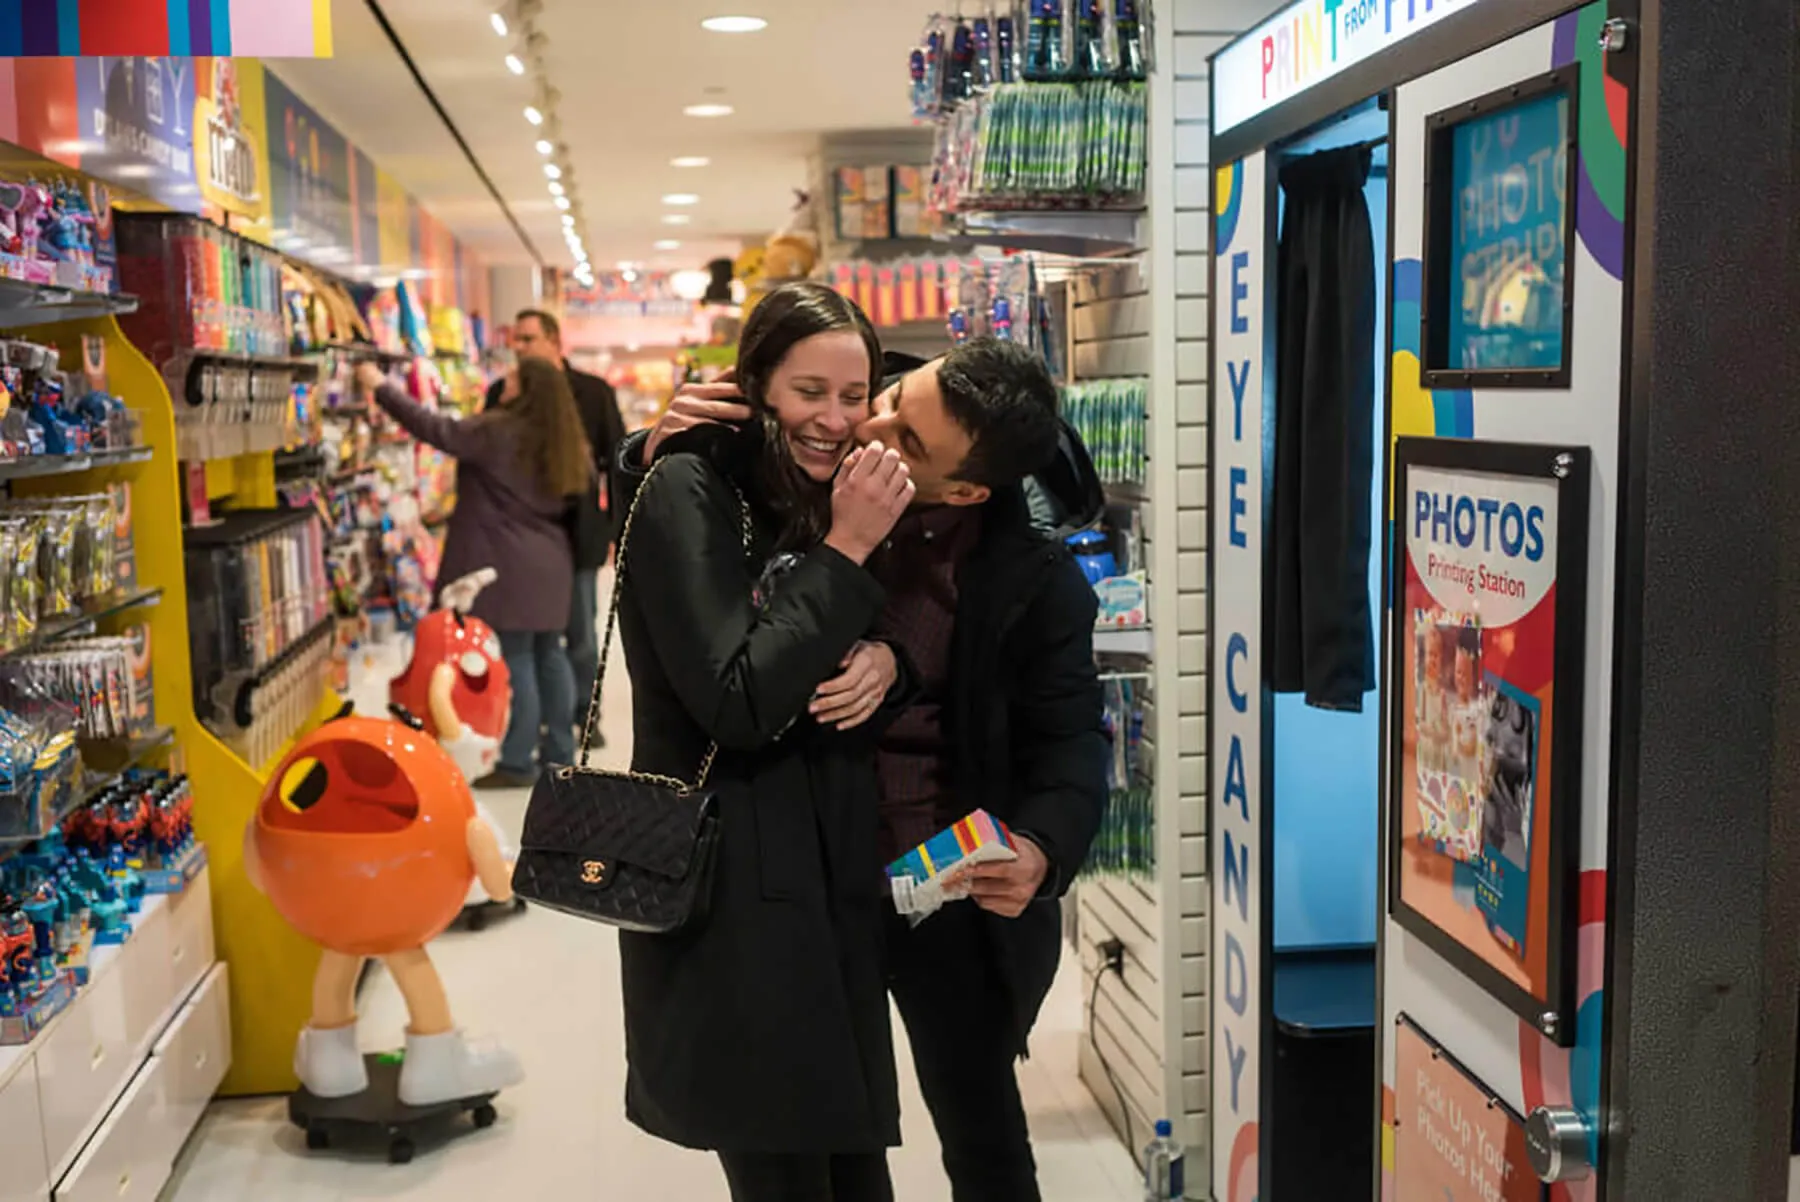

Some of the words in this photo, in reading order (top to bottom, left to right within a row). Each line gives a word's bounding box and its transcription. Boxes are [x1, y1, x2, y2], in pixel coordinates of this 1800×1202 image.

[1261, 0, 1343, 99] PRINT
[1344, 0, 1378, 40] FROM
[1226, 251, 1251, 549] EYE
[1415, 490, 1545, 563] PHOTOS
[1428, 553, 1475, 594] Printing
[1478, 564, 1526, 598] Station
[1223, 632, 1250, 1114] CANDY
[1416, 1067, 1445, 1119] Pick
[1449, 1096, 1471, 1149] Up
[1475, 1122, 1515, 1182] Your
[1417, 1105, 1466, 1177] Photos
